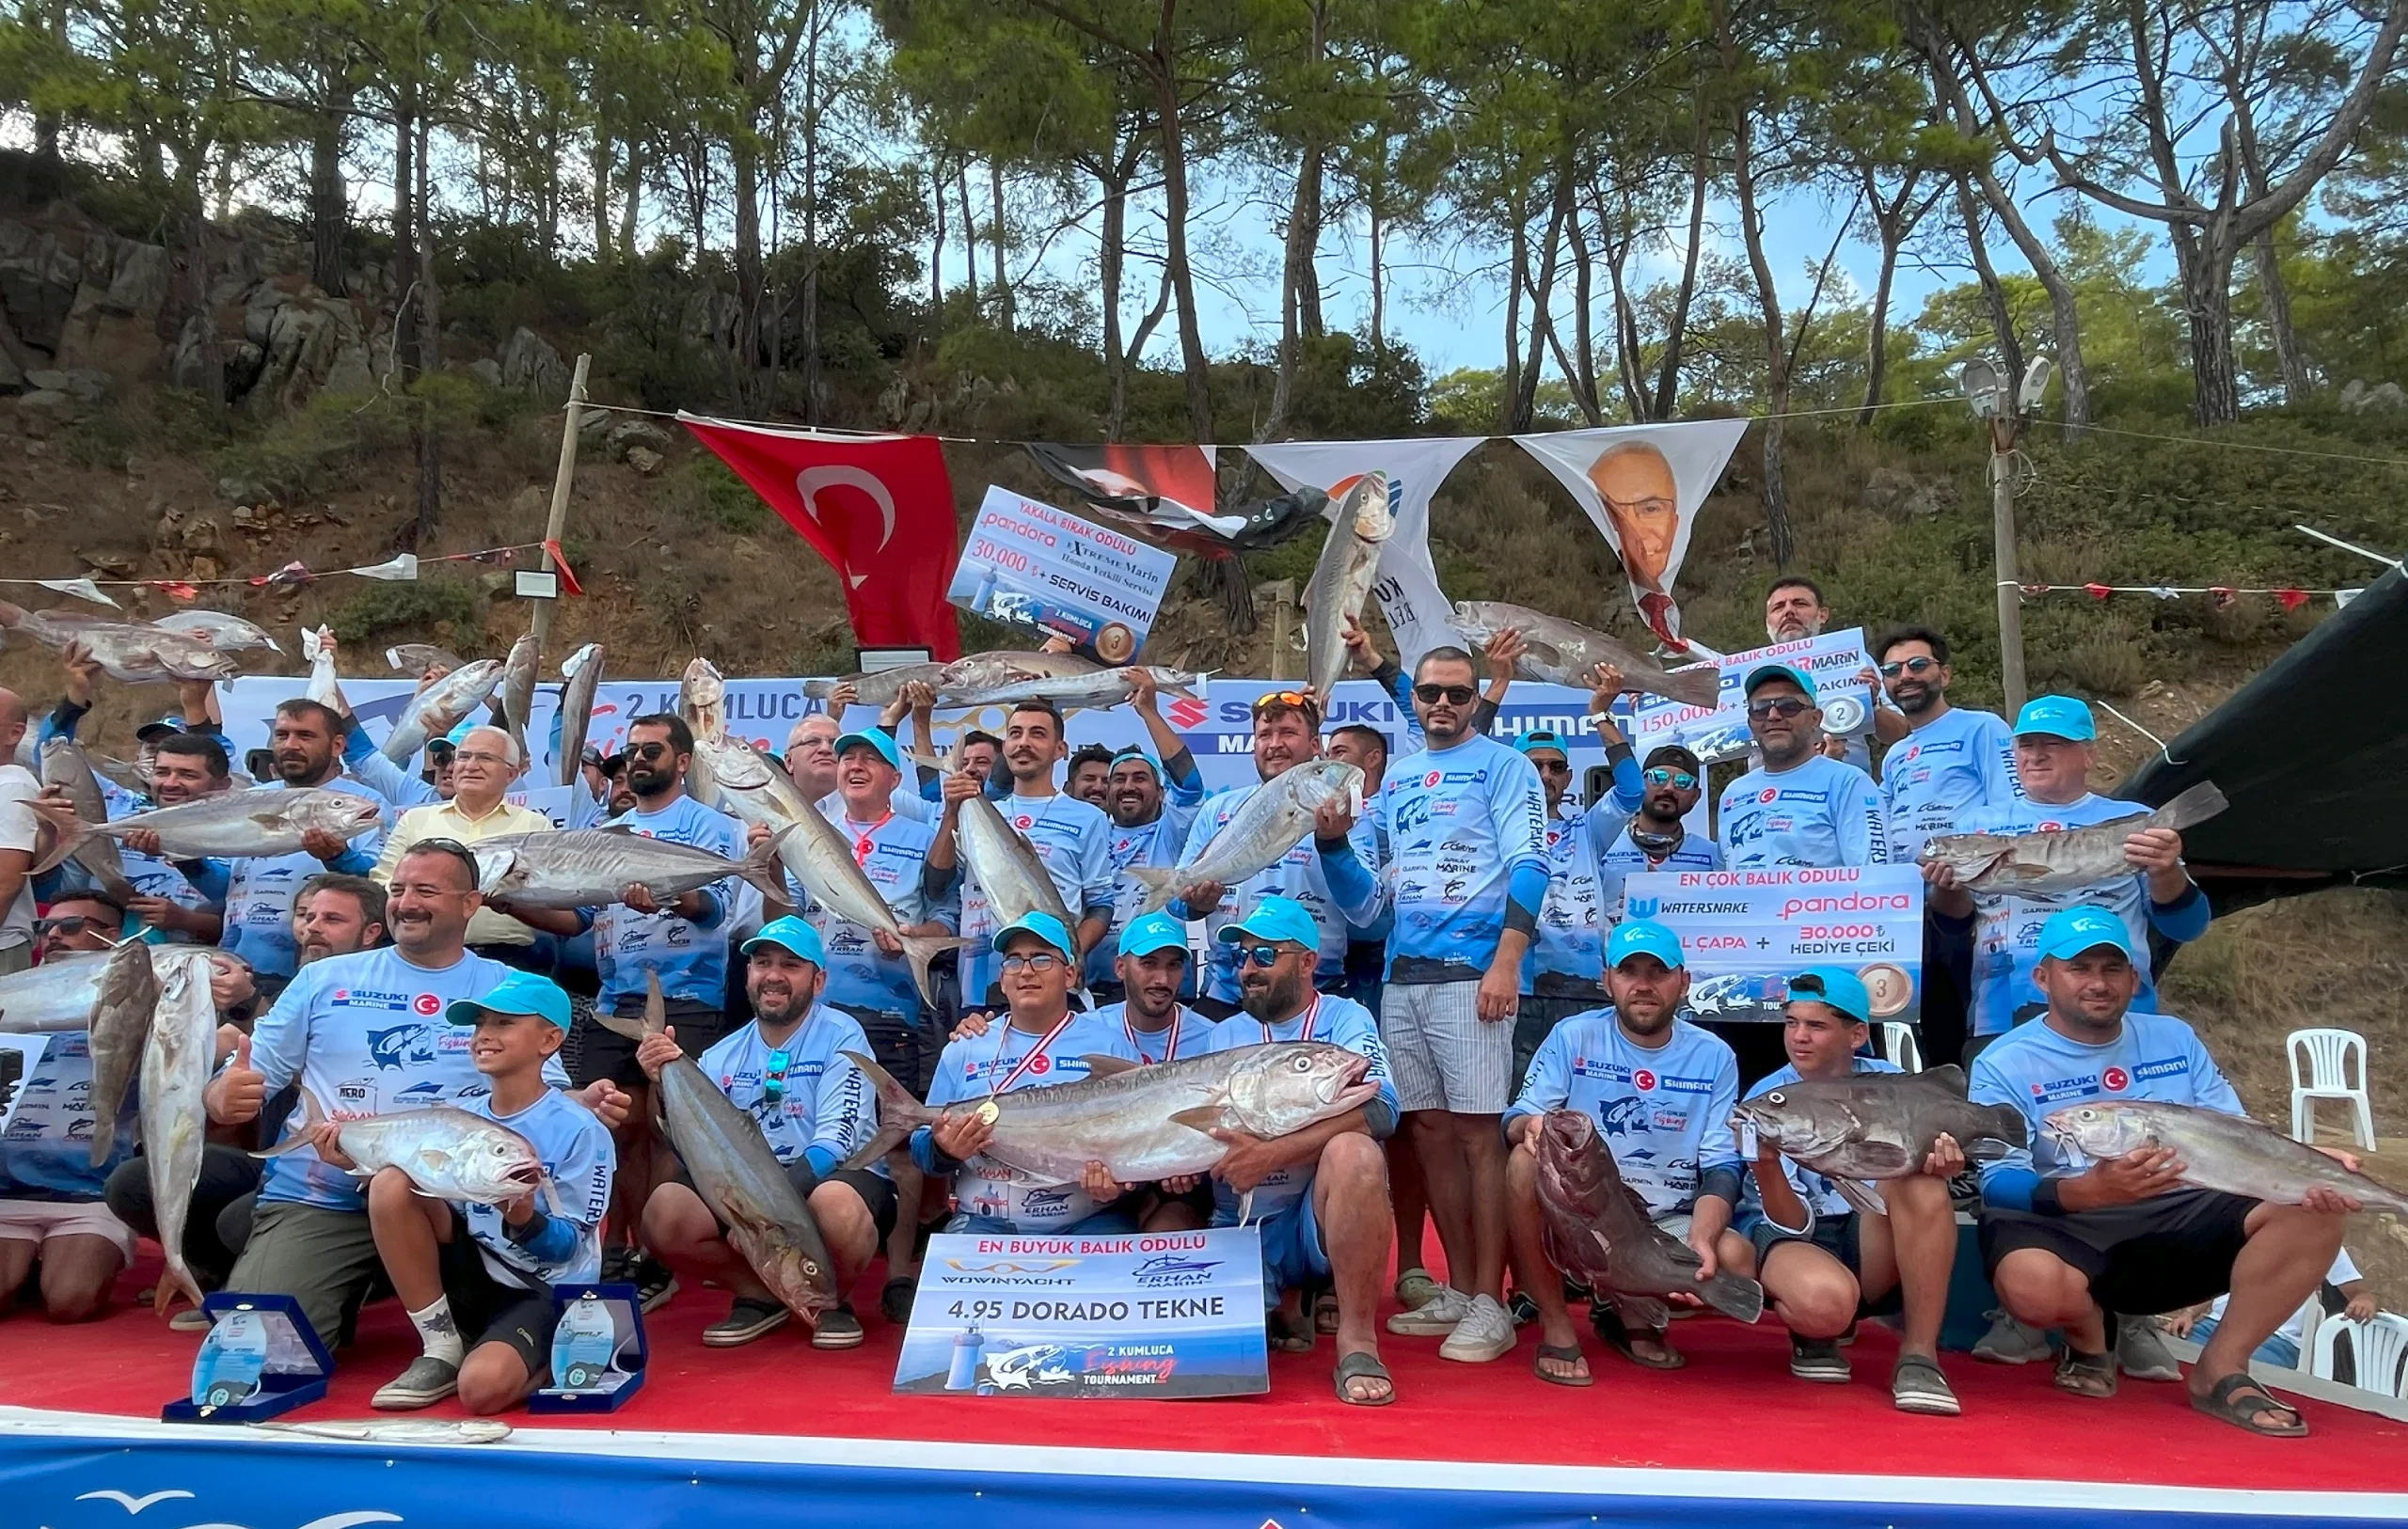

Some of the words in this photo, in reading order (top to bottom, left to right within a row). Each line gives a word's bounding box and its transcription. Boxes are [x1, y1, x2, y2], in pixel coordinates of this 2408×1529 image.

[1019, 501, 1057, 526] YAKALA
[1060, 517, 1094, 540] BIRAK
[981, 512, 1056, 548] pandora
[972, 539, 1027, 572] 30.000
[1049, 574, 1100, 602] SERVİS
[1101, 595, 1151, 623] BAKIMI
[1725, 651, 1762, 667] BALIK
[626, 694, 643, 720] 2
[1836, 707, 1846, 721] 2
[1782, 792, 1826, 802] SHIMANO
[1915, 822, 1955, 831] MARINE
[1988, 823, 2034, 832] SUZUKI
[881, 845, 924, 859] SHIMANO
[1435, 863, 1477, 873] MARINE
[1680, 874, 1701, 886] EN
[1706, 873, 1740, 890] ÇOK
[1746, 870, 1793, 885] BALIK
[1661, 903, 1749, 914] WATERSNAKE
[1776, 891, 1909, 921] pandora
[1697, 937, 1747, 953] ÇAPA
[1791, 939, 1851, 954] HEDİYE
[1856, 938, 1894, 957] ÇEKİ
[351, 990, 408, 1001] SUZUKI
[1876, 979, 1887, 998] 3
[349, 1000, 390, 1010] MARINE
[1587, 1060, 1631, 1073] SUZUKI
[1585, 1070, 1618, 1081] MARINE
[2043, 1074, 2097, 1091] SUZUKI
[2047, 1089, 2084, 1103] MARINE
[1024, 1205, 1069, 1214] ERHAN
[978, 1240, 1004, 1253] EN
[1009, 1237, 1074, 1254] BÜYÜK
[1080, 1240, 1133, 1254] BALIK
[1139, 1232, 1206, 1253] ÖDÜLÜ
[942, 1276, 1075, 1285] WOWINYACHT
[1137, 1271, 1212, 1284] ERHAN
[948, 1300, 1003, 1319] 4.95
[1012, 1300, 1129, 1321] DORADO
[1137, 1297, 1224, 1319] TEKNE
[1083, 1374, 1156, 1385] TOURNAMENT
